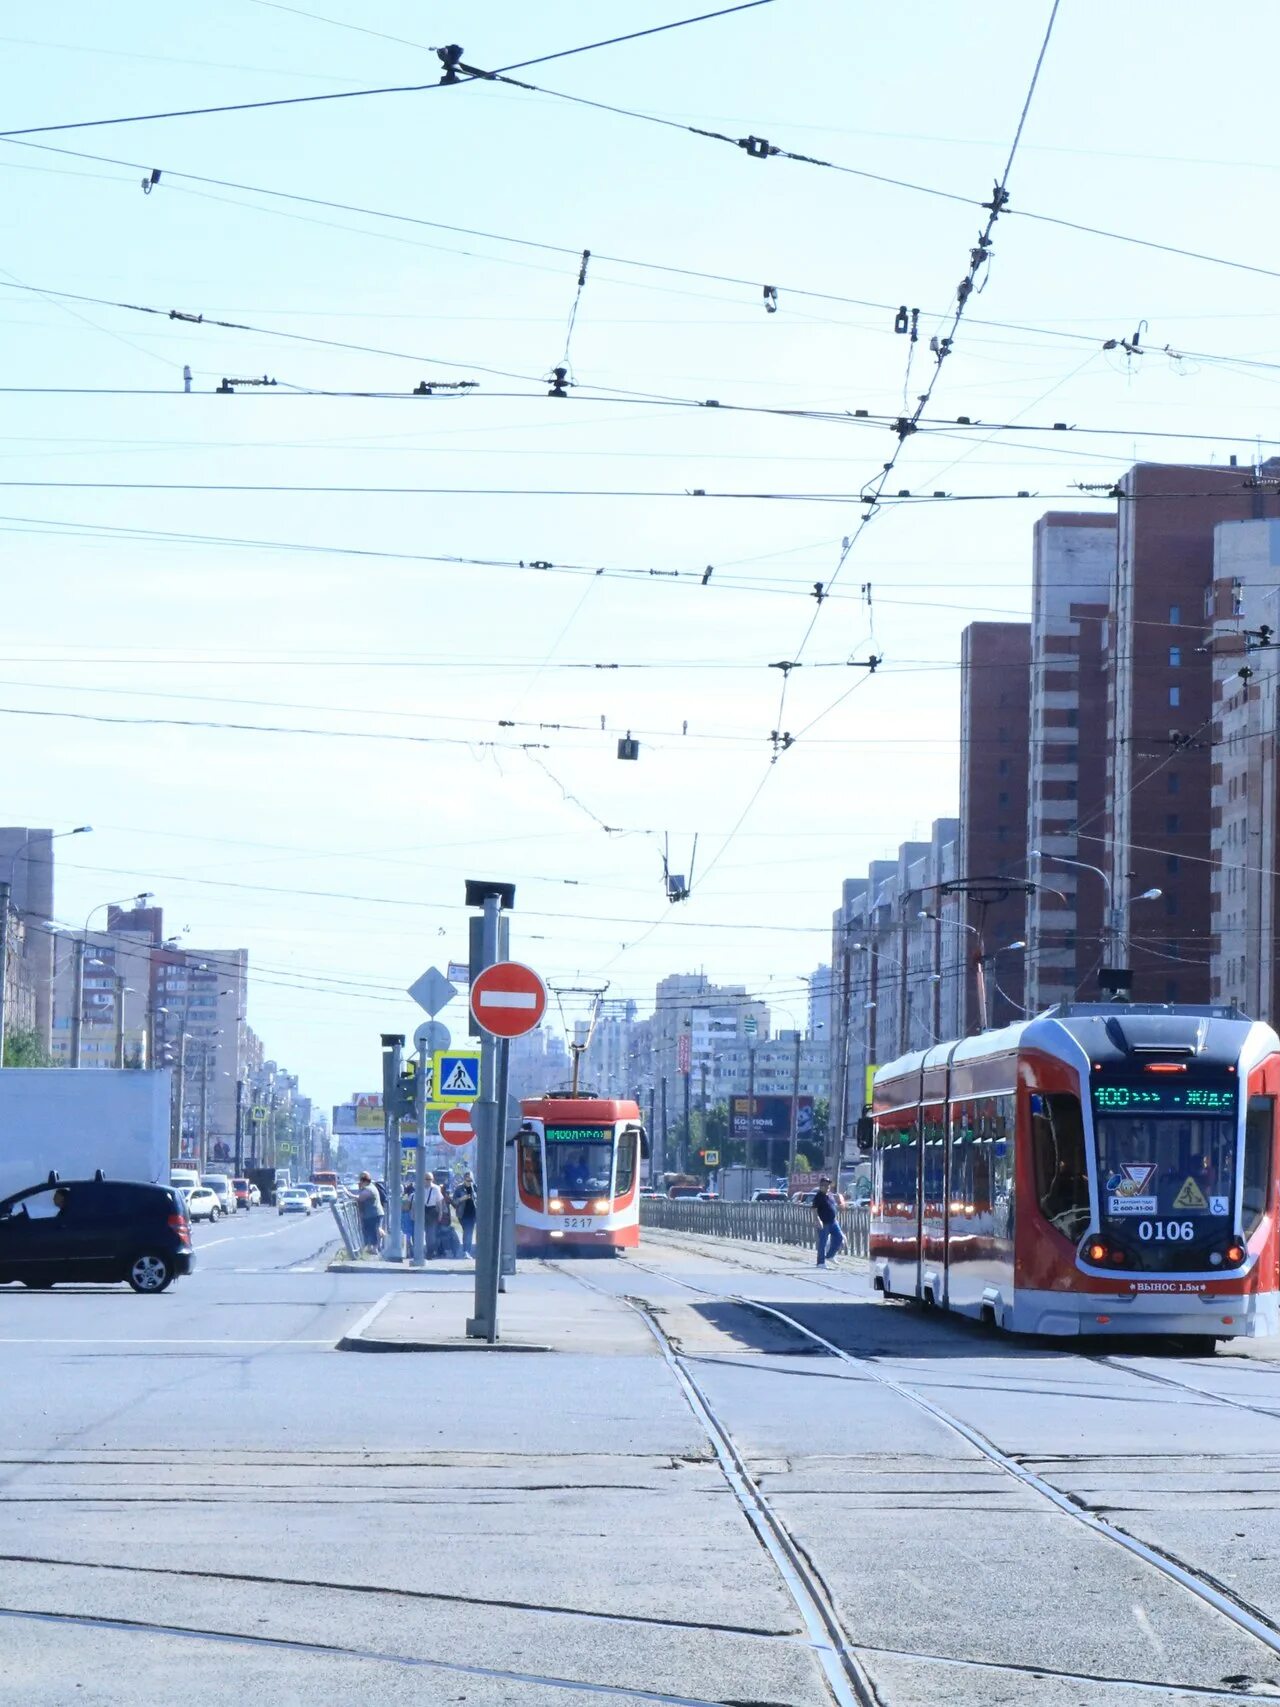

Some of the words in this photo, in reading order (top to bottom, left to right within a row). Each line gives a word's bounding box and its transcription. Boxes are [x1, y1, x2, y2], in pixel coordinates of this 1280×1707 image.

[564, 1218, 592, 1228] 5217
[1138, 1221, 1194, 1240] 0106
[1137, 1283, 1176, 1291] ВЫНОС
[1180, 1283, 1199, 1291] 1.5м
